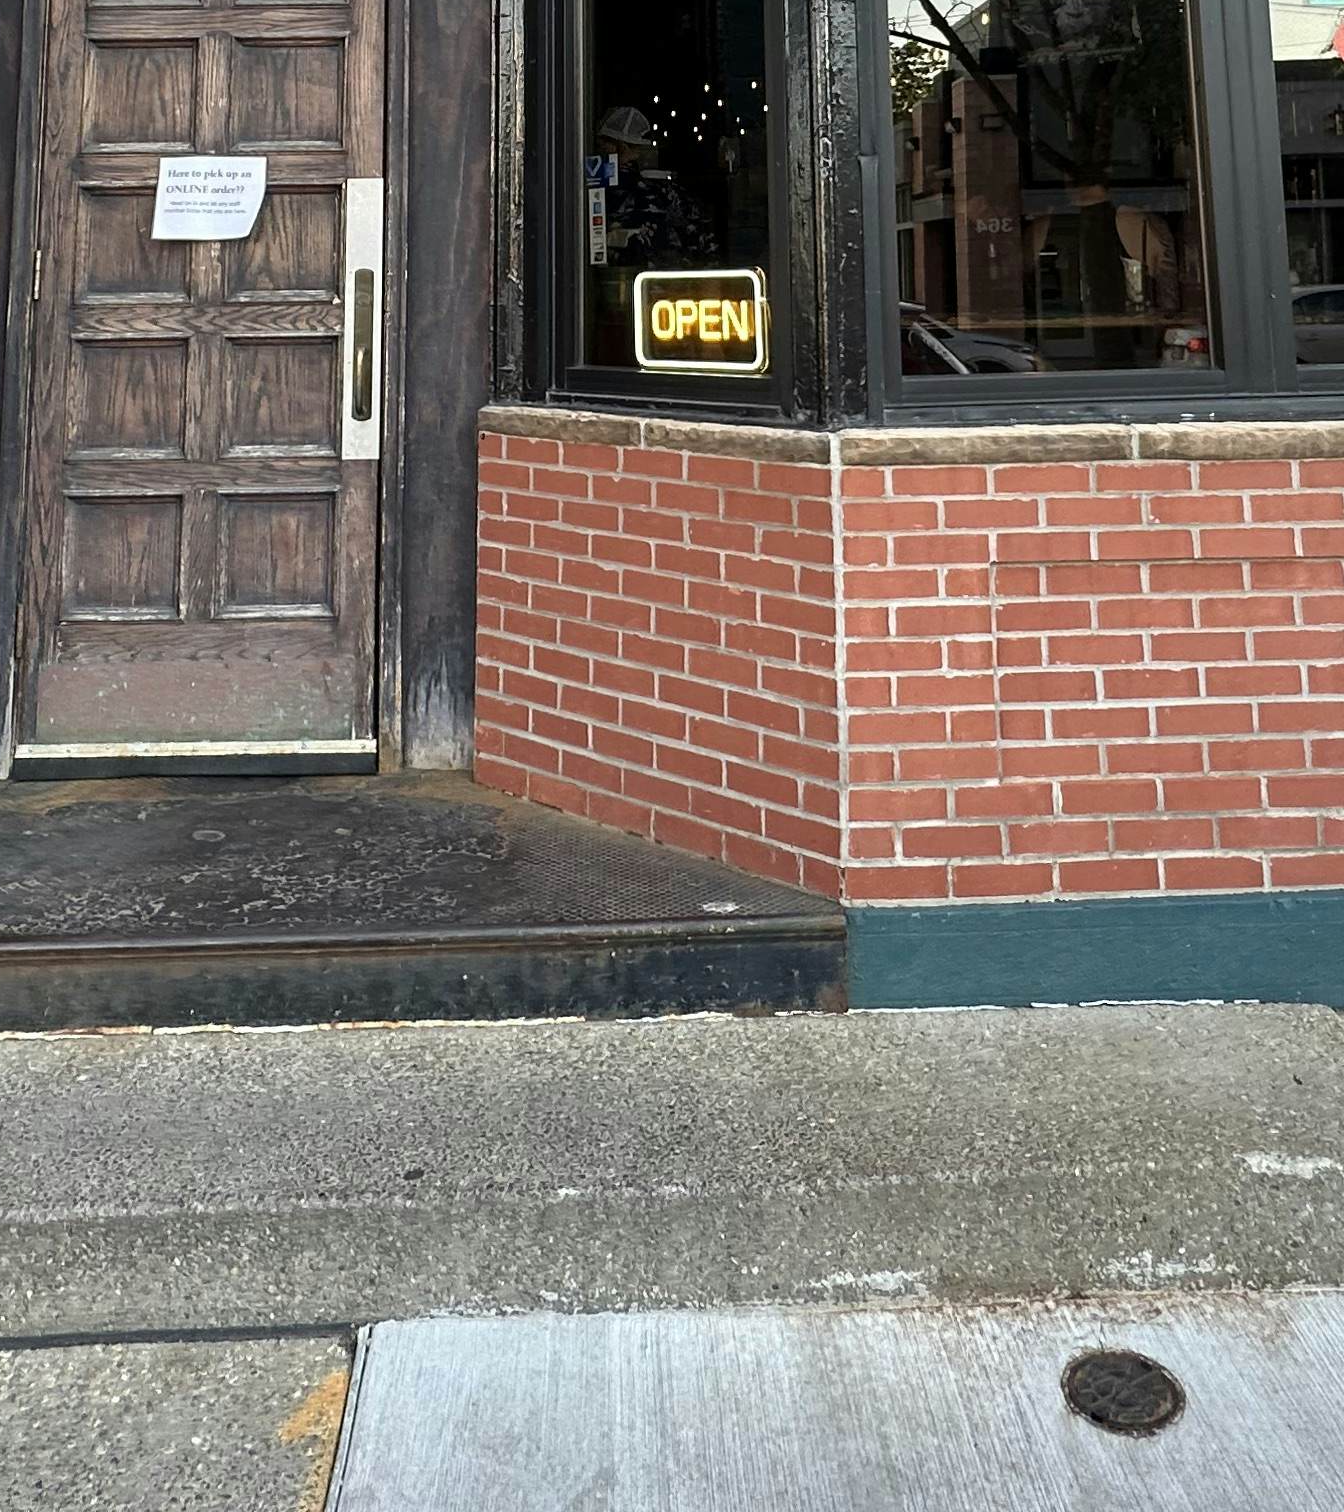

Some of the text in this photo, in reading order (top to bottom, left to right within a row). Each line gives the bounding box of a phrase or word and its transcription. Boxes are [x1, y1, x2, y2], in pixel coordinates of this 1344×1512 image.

[168, 169, 189, 178] Here
[191, 170, 201, 178] to
[204, 169, 223, 180] pick
[226, 171, 238, 180] up
[166, 185, 209, 194] ONLINE
[651, 299, 750, 341] OPEN
